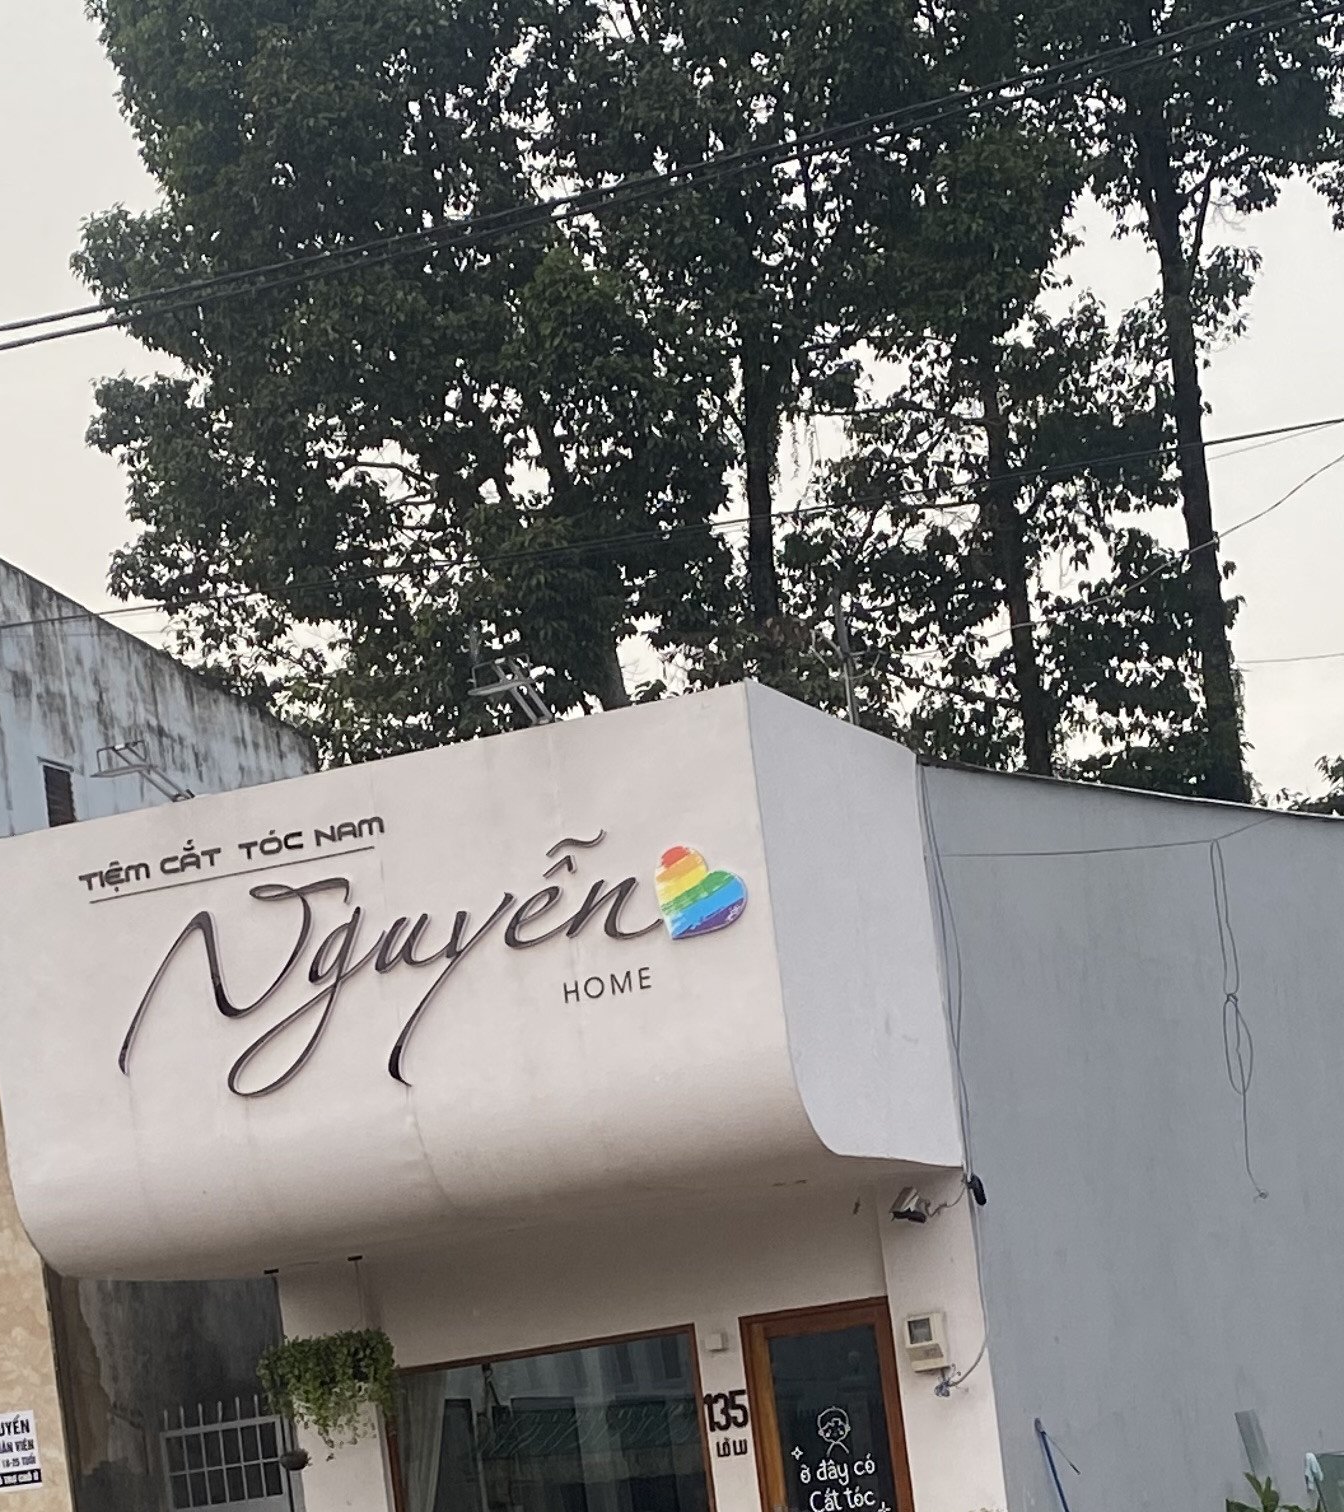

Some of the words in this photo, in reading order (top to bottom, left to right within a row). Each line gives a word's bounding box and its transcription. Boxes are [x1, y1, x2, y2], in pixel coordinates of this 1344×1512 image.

[78, 860, 151, 892] TIỆM
[159, 839, 222, 874] CẮT
[238, 829, 304, 860] TÓC
[314, 816, 385, 847] NAM
[117, 828, 666, 1098] Nguyễn
[562, 966, 653, 1004] HOME
[703, 1389, 749, 1432] 135
[816, 1459, 850, 1486] đây
[853, 1453, 876, 1475] có
[843, 1486, 876, 1509] tóc
